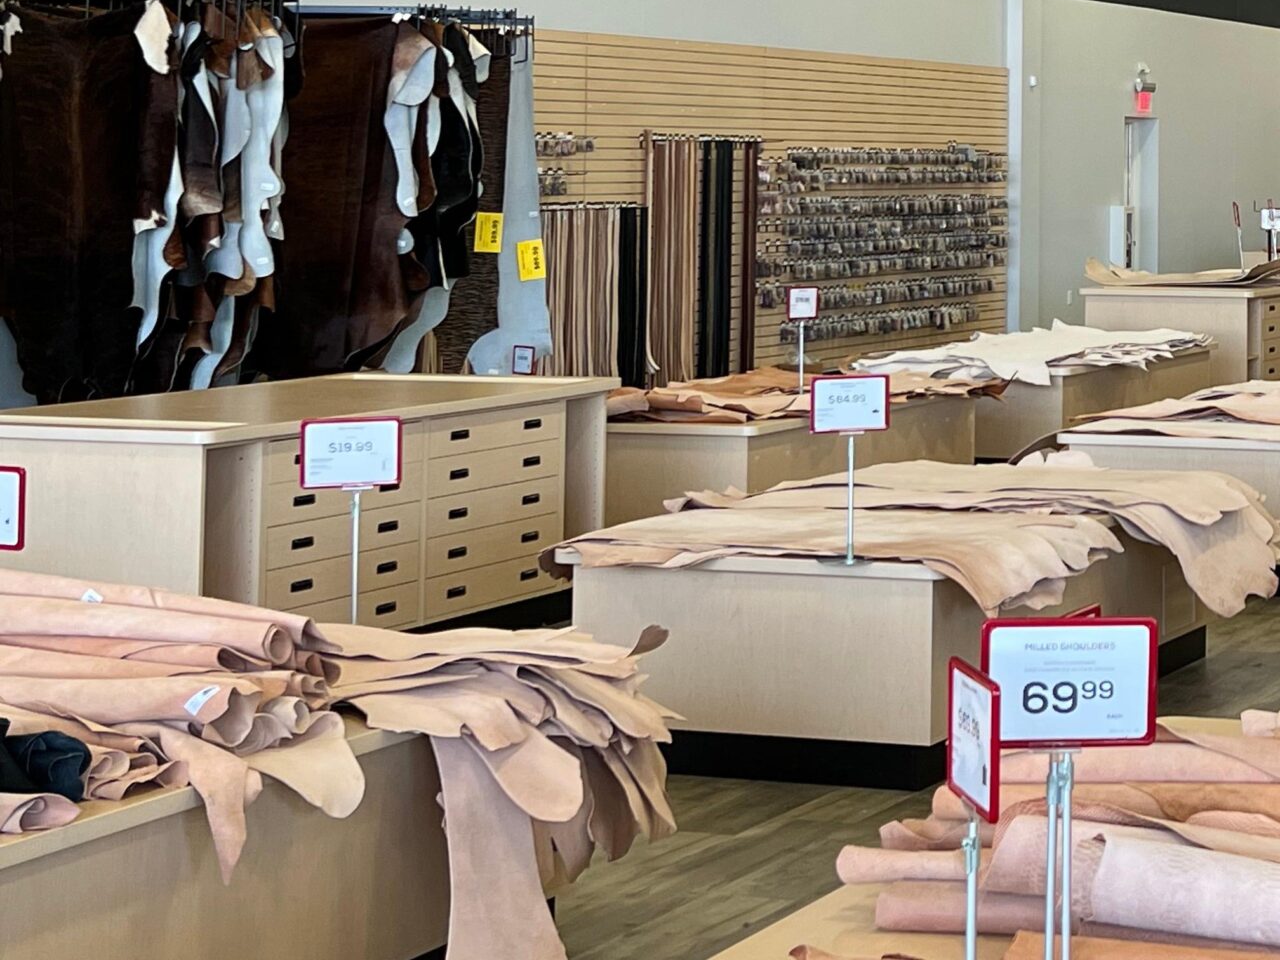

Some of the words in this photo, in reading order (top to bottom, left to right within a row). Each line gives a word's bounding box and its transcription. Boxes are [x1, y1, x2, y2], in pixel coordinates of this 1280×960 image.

[328, 441, 373, 454] $19.99
[1024, 642, 1058, 651] MILLED
[1060, 642, 1116, 651] SHOULDERS
